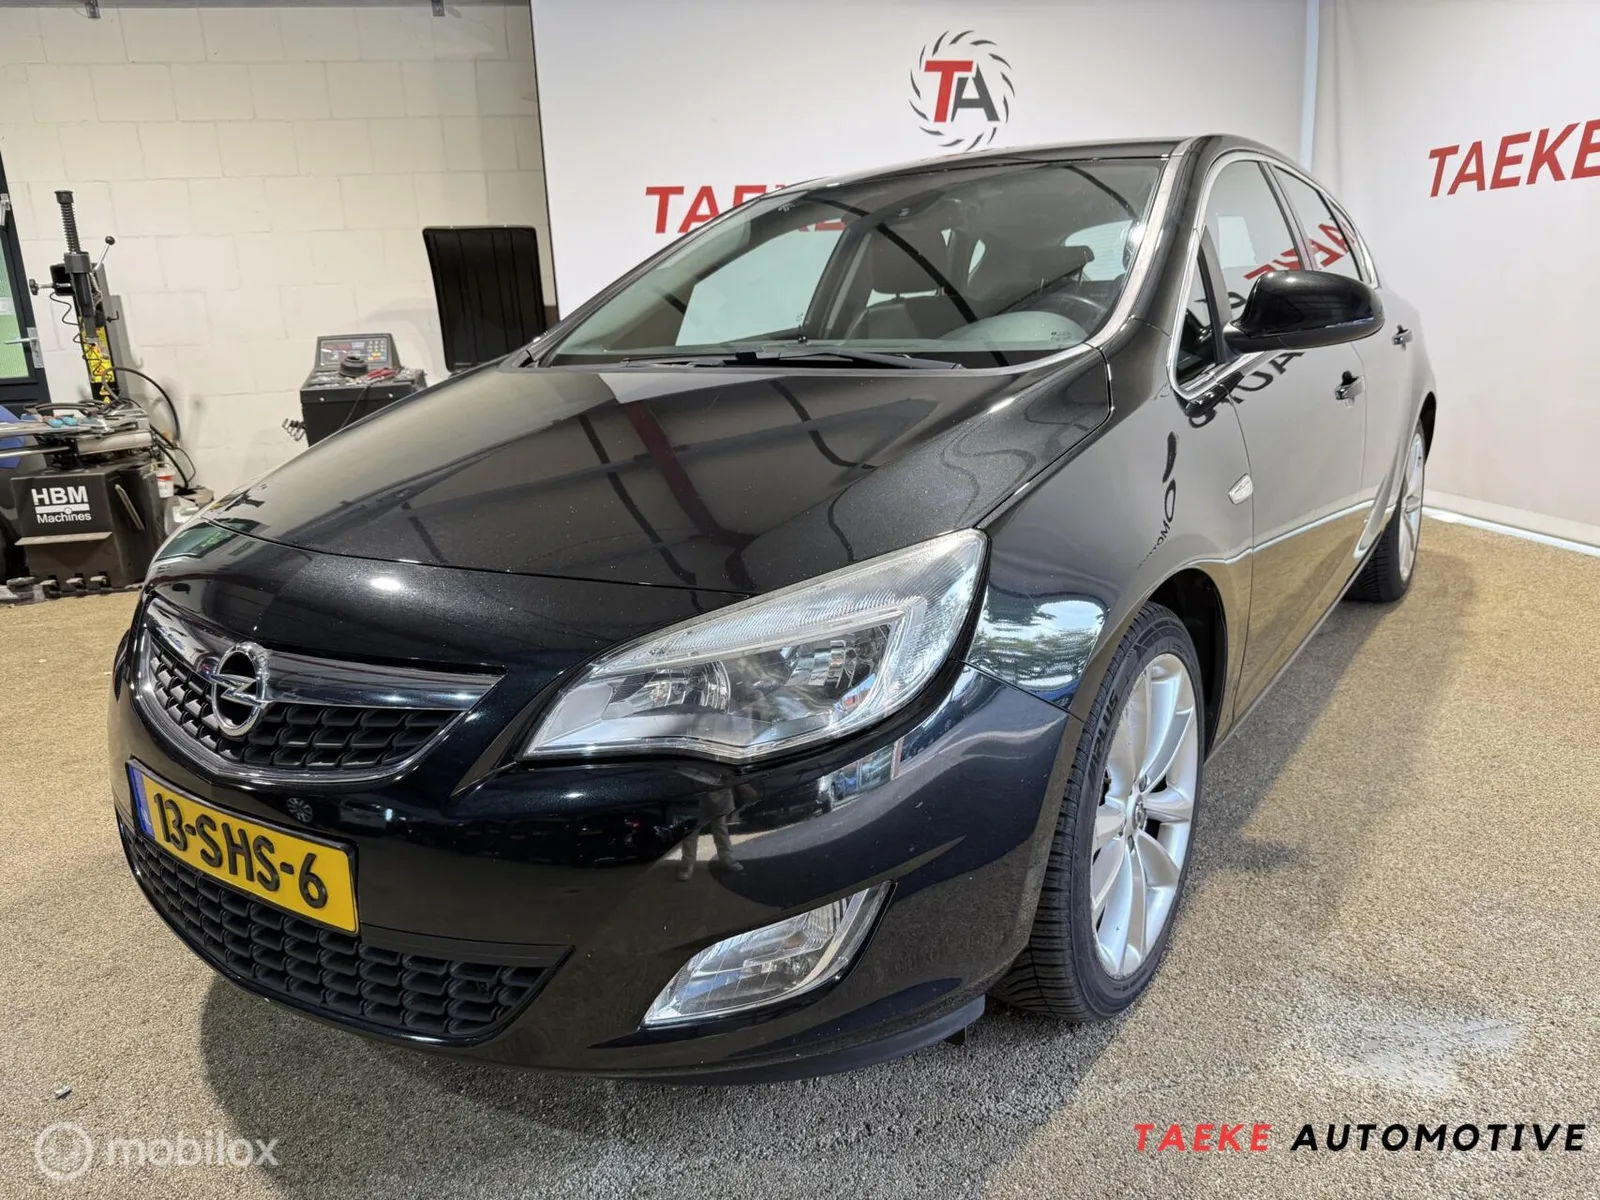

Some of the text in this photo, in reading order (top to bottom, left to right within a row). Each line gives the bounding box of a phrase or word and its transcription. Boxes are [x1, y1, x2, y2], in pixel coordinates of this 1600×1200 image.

[924, 60, 1001, 123] TA
[1428, 118, 1600, 198] TAEKE
[31, 485, 89, 506] HBM
[37, 511, 92, 524] Machines
[153, 792, 328, 909] 13-SHS-6
